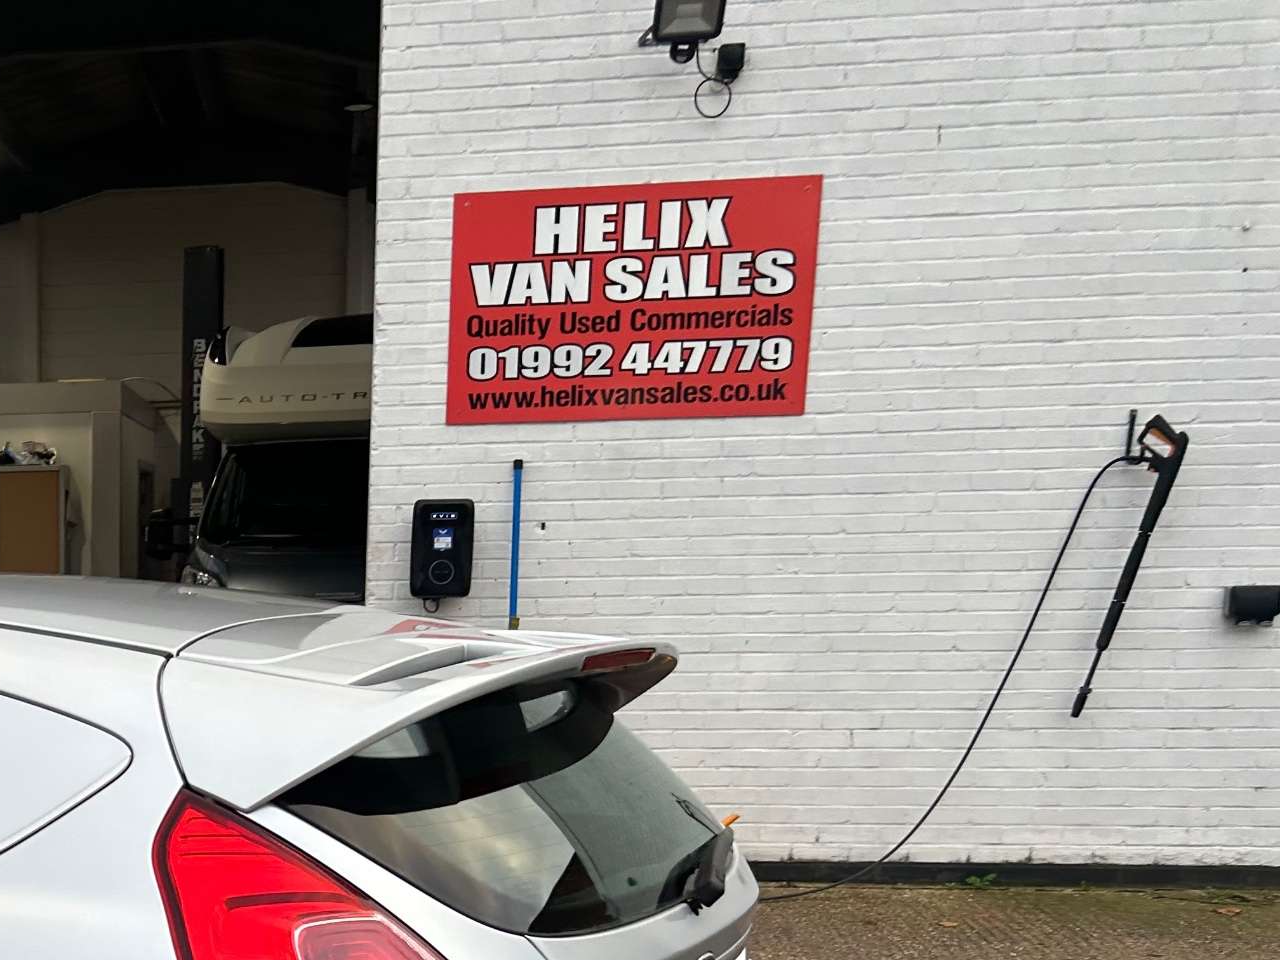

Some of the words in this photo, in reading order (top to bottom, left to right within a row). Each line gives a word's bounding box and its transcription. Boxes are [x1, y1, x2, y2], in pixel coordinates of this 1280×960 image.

[532, 196, 733, 257] HELIX
[469, 259, 592, 307] VAN
[603, 249, 796, 301] SALES
[466, 312, 551, 340] Quality
[560, 309, 620, 334] Used
[630, 304, 793, 332] Commercials
[467, 343, 613, 381] 01992
[619, 336, 794, 376] 447779
[468, 379, 787, 410] www.helixvansales.co.uk
